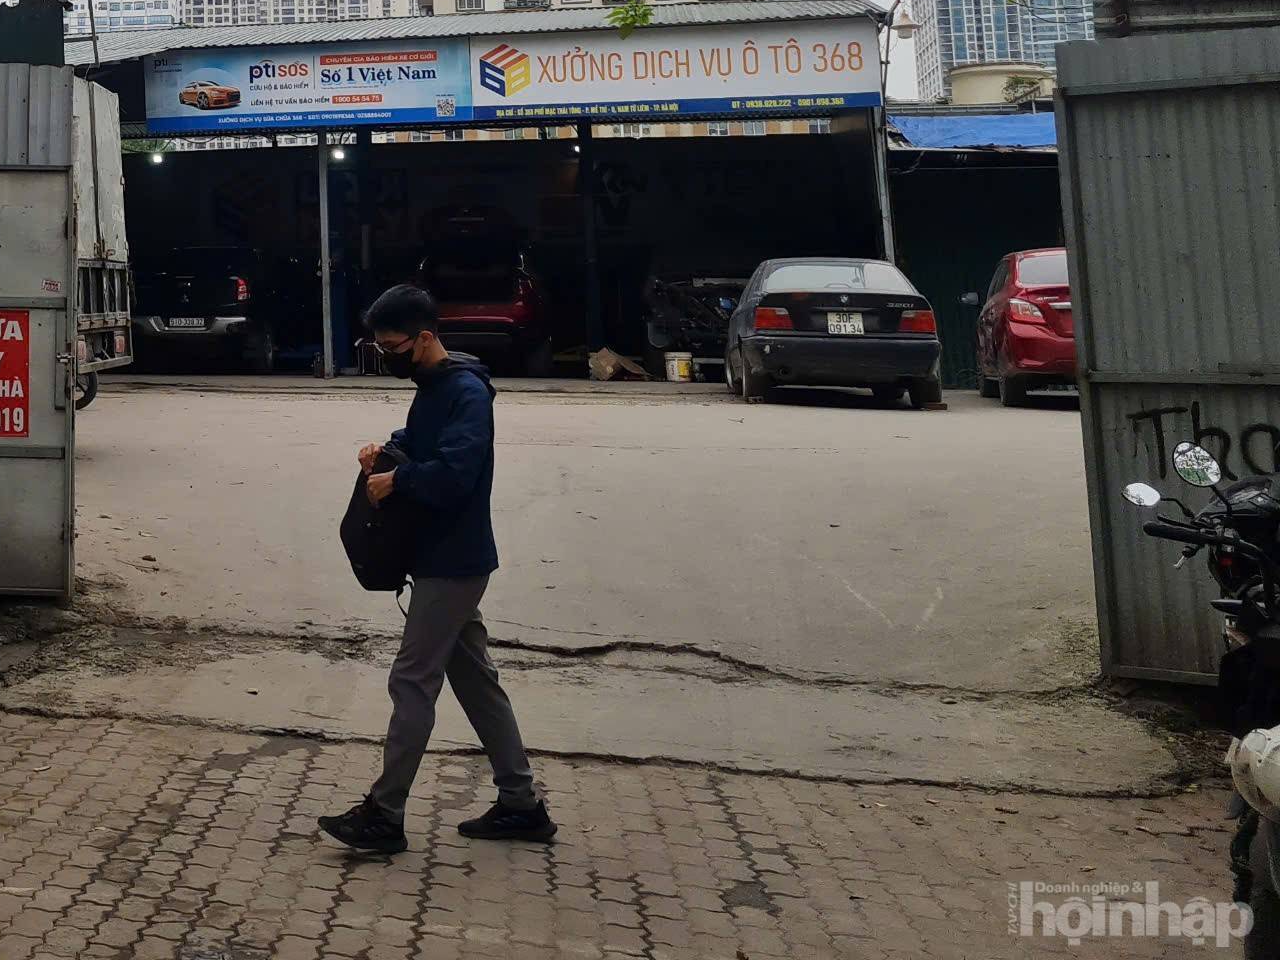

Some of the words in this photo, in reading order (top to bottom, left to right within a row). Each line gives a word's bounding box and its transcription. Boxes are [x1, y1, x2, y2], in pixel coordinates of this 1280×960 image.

[536, 46, 623, 83] XƯỞNG
[633, 48, 691, 86] DỊCH
[698, 47, 732, 83] VỤ
[742, 39, 760, 75] Ô
[768, 37, 802, 74] TÔ
[812, 41, 863, 73] 368
[320, 68, 341, 83] Số
[346, 67, 354, 81] 1
[357, 67, 392, 84] Việt
[398, 66, 437, 80] Nam
[835, 313, 852, 323] 30F
